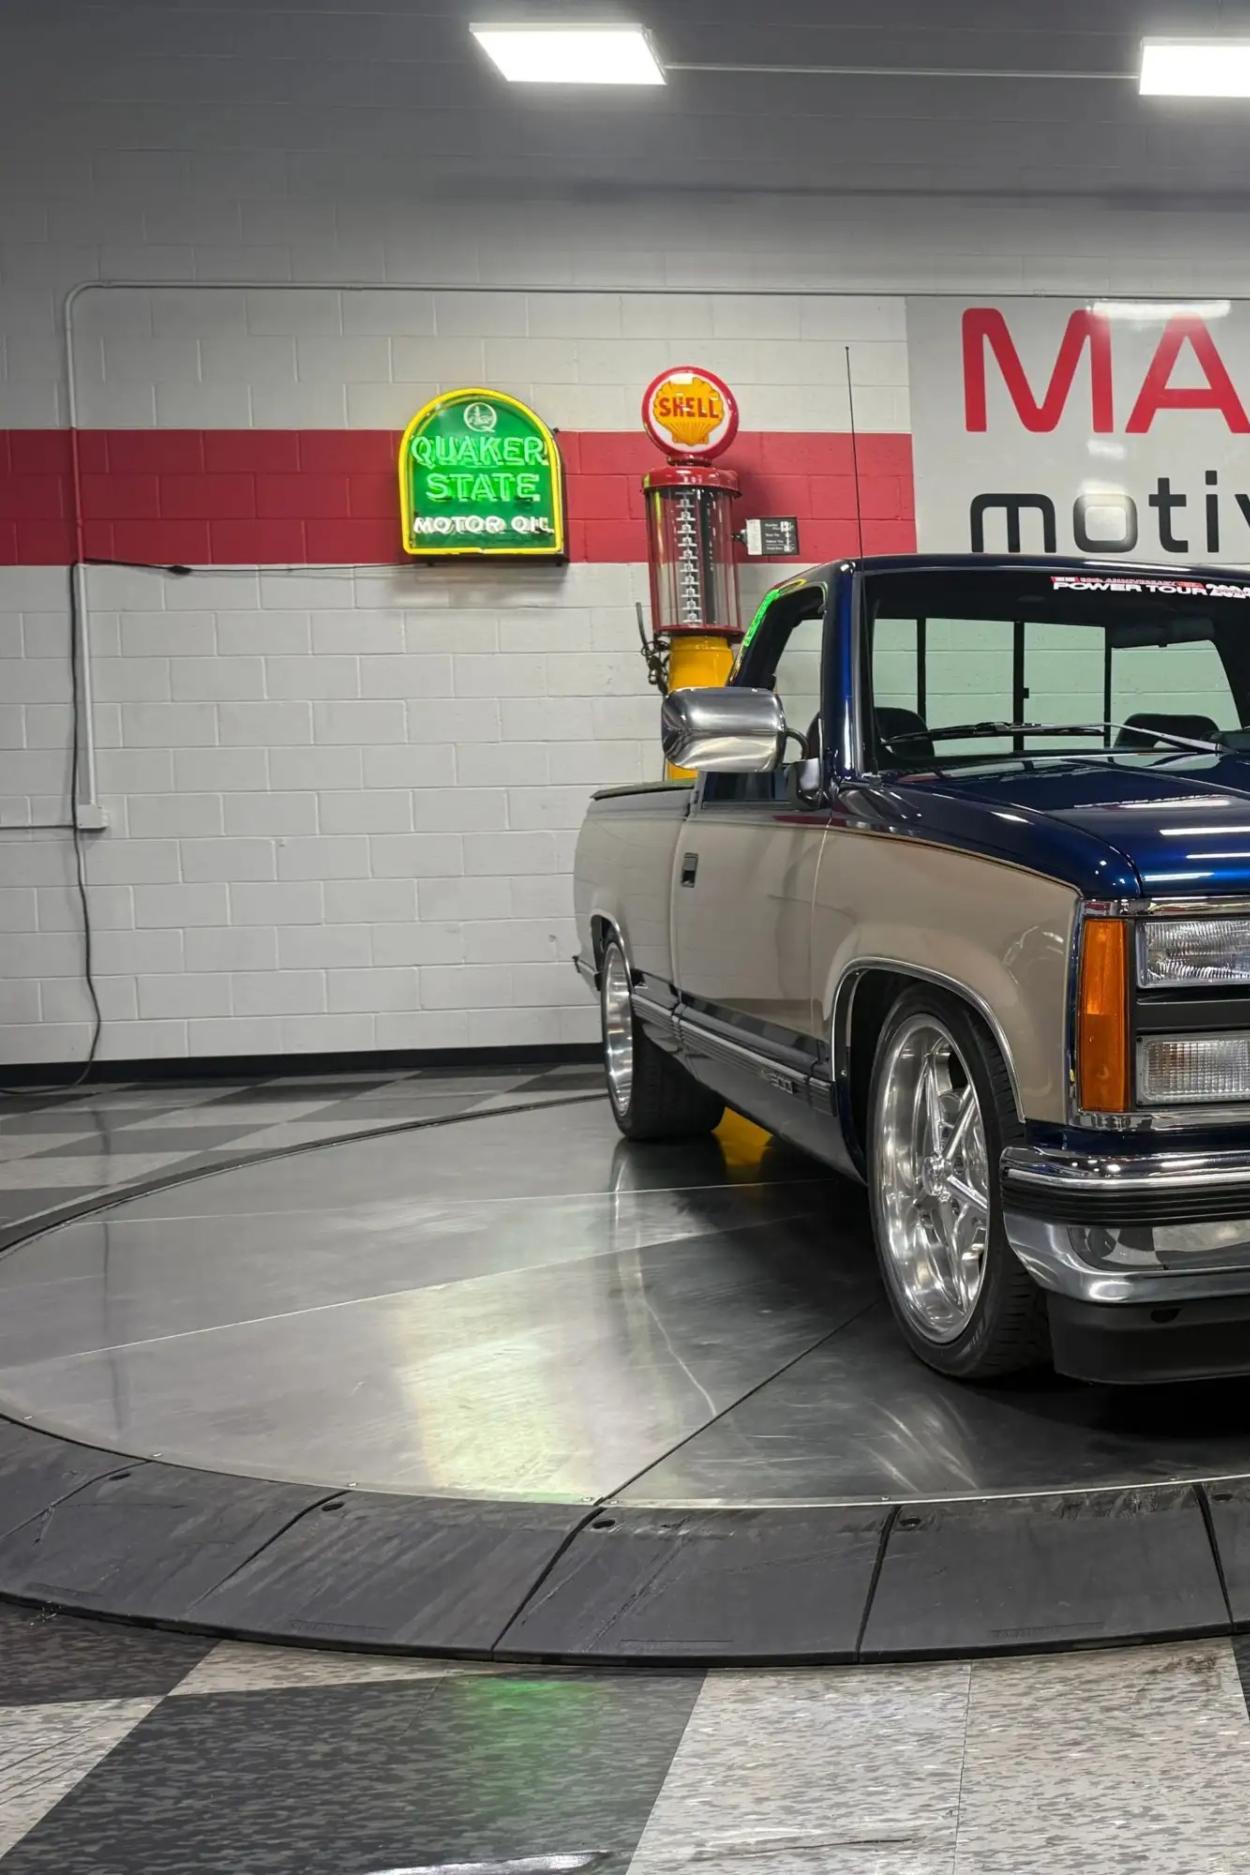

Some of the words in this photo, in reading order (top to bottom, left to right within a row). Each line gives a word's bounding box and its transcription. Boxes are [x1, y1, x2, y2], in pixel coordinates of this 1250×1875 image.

[658, 396, 721, 420] SHELL
[411, 435, 549, 469] QUAKER
[425, 472, 541, 502] STATE
[413, 515, 507, 535] MOTOR
[511, 515, 555, 534] OIL
[1052, 581, 1143, 592] POWER
[1145, 584, 1208, 596] TOUR
